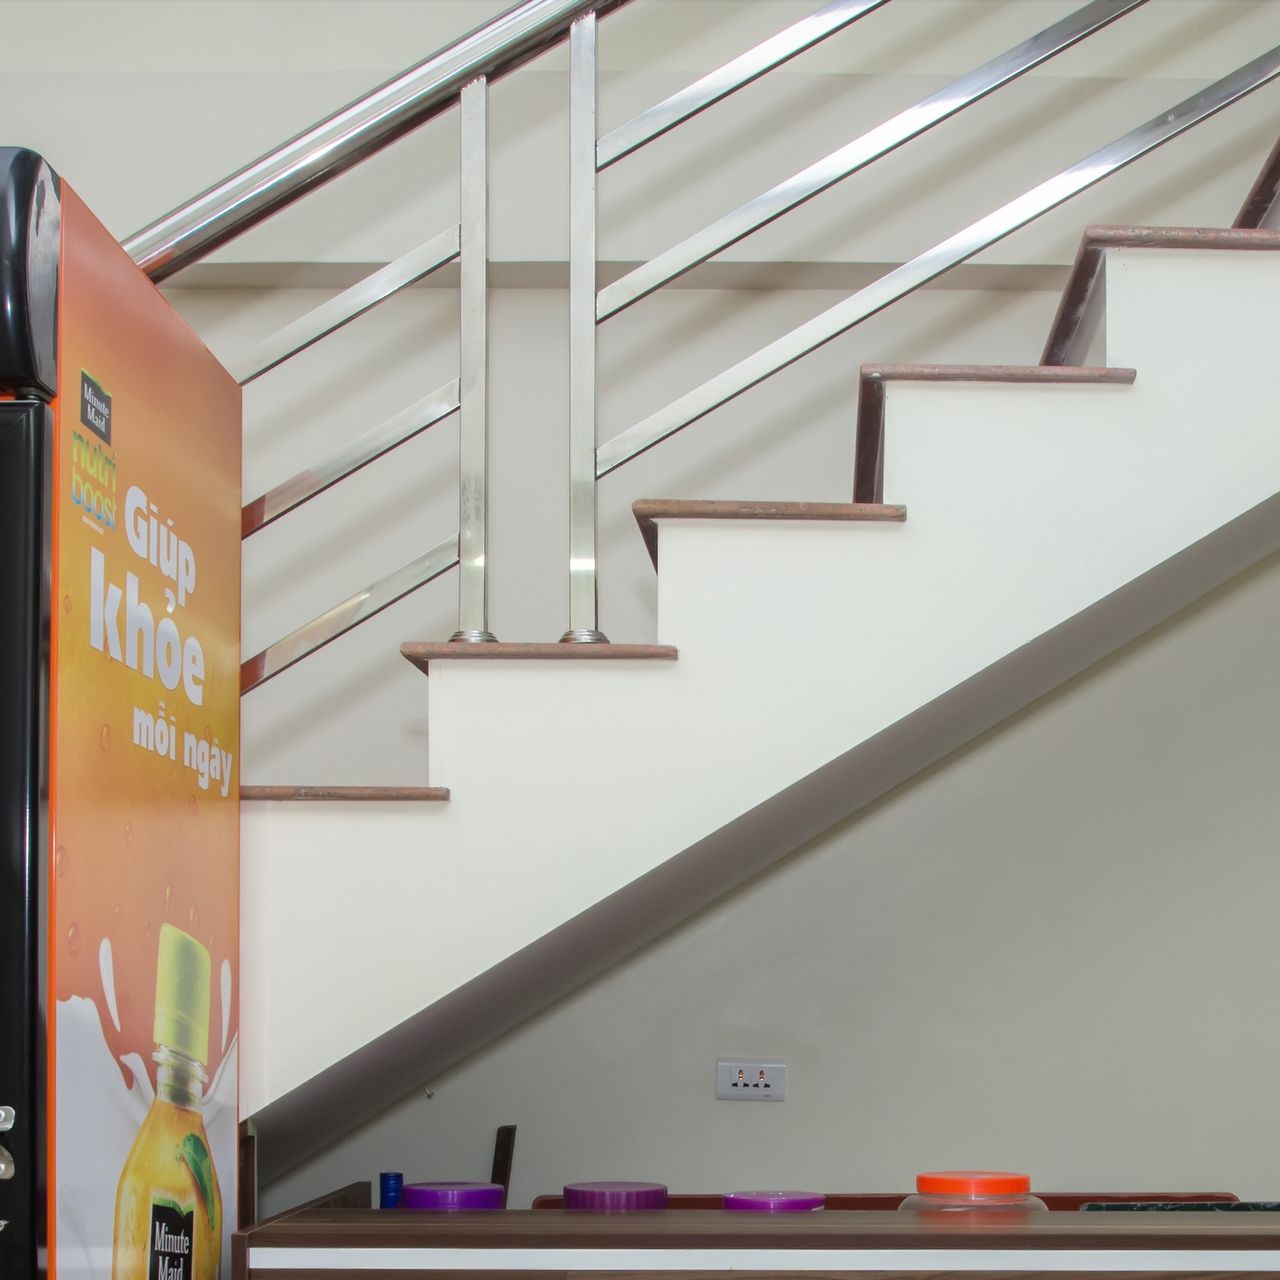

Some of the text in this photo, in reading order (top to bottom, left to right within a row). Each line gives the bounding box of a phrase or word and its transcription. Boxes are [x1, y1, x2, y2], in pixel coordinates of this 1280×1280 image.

[84, 382, 109, 418] Minute
[87, 403, 106, 433] Maid
[124, 485, 196, 607] Giúp
[89, 546, 205, 707] khỏe
[133, 700, 233, 797] mỗi ngày
[154, 1219, 190, 1256] Minute
